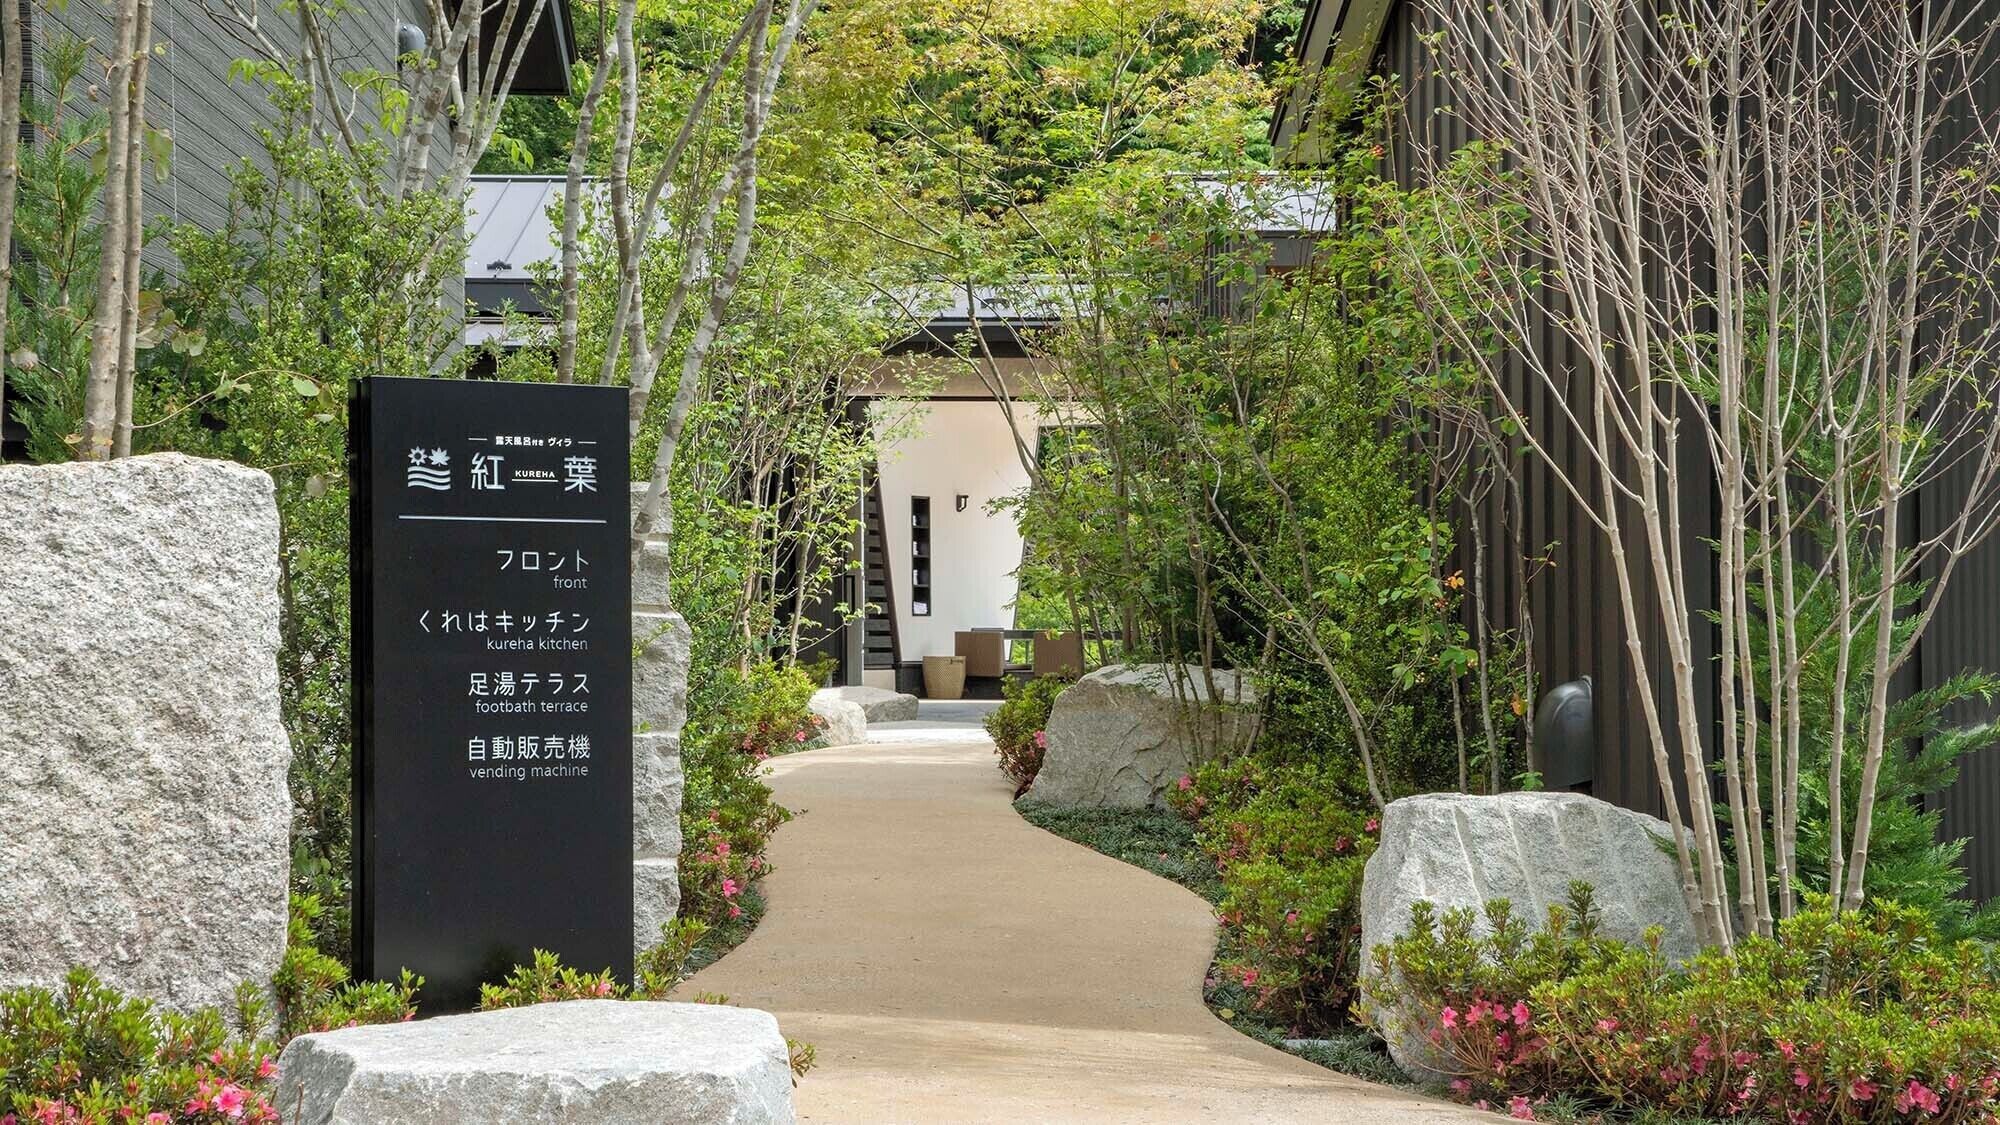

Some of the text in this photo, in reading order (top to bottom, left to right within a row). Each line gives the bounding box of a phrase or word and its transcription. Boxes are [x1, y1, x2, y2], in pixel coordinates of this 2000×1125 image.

[495, 435, 572, 447] 露天風呂付き ヴィラ
[470, 451, 598, 493] 紅 KUREHA 葉
[496, 548, 589, 572] フロント
[553, 574, 588, 589] front
[419, 609, 590, 633] くれはキッチン
[486, 636, 588, 650] kureha kitchen
[468, 671, 590, 696] 足湯テラス
[475, 699, 588, 713] footbath terrace
[468, 733, 591, 761] 自動販売機
[469, 763, 589, 781] vending machine
